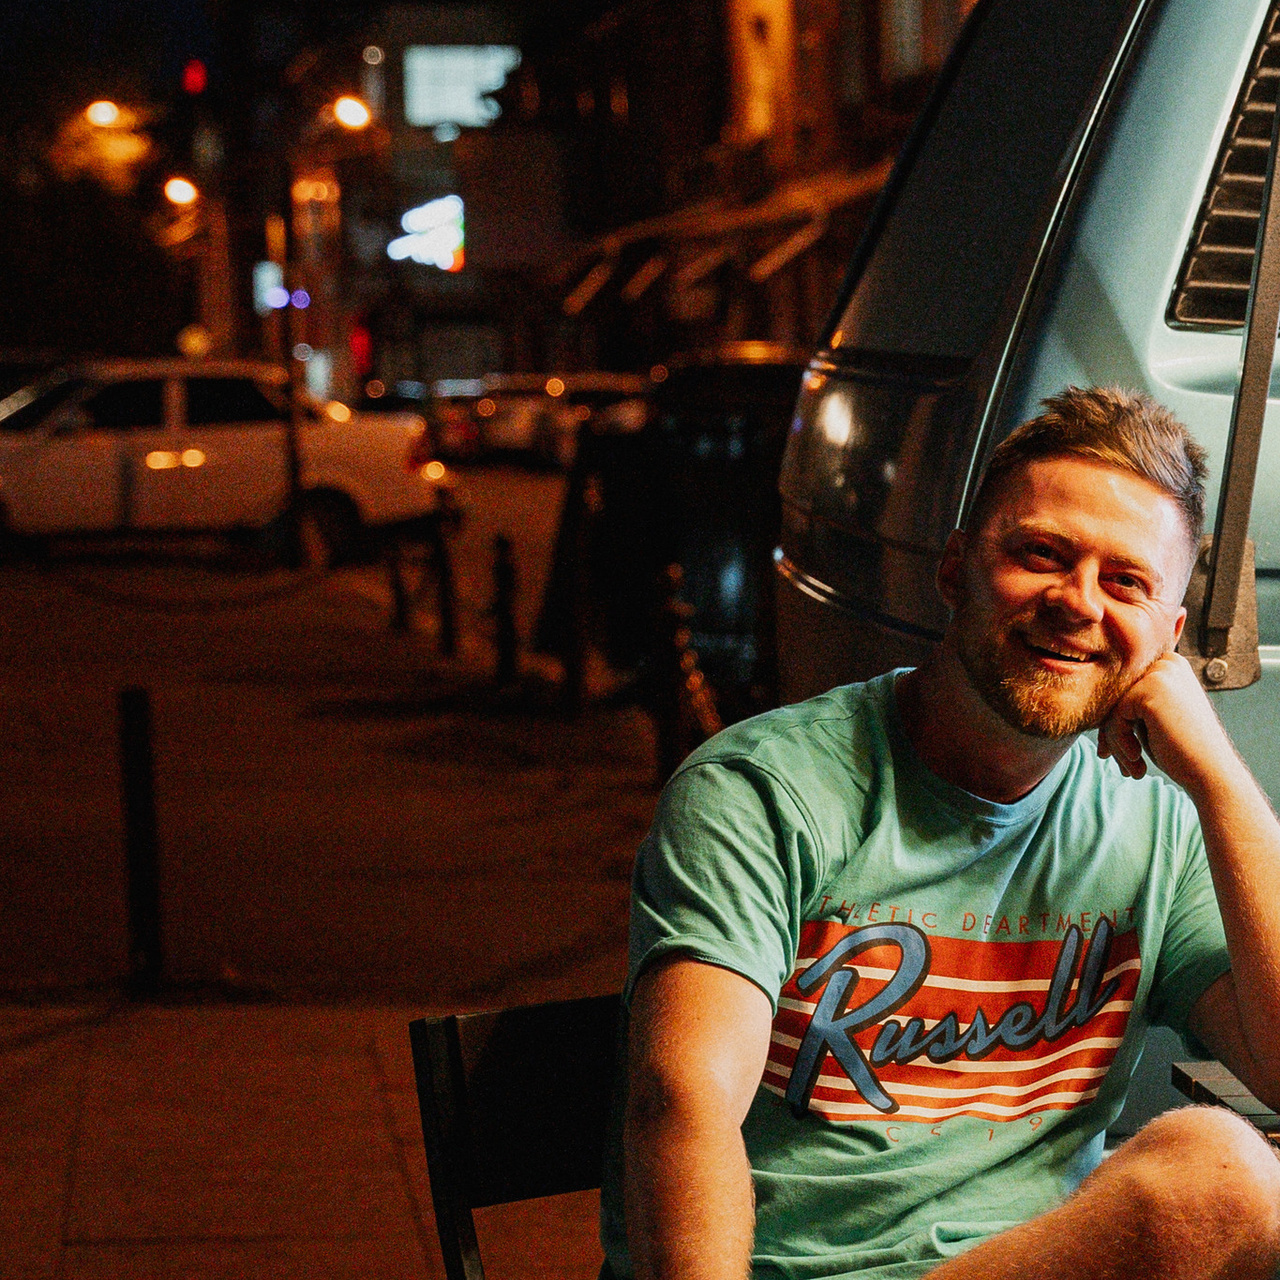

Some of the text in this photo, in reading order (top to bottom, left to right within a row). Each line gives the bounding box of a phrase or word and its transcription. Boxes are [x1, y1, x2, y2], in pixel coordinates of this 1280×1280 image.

[819, 896, 1136, 935] THLETIC DEARTMENT
[786, 915, 1121, 1118] Russell
